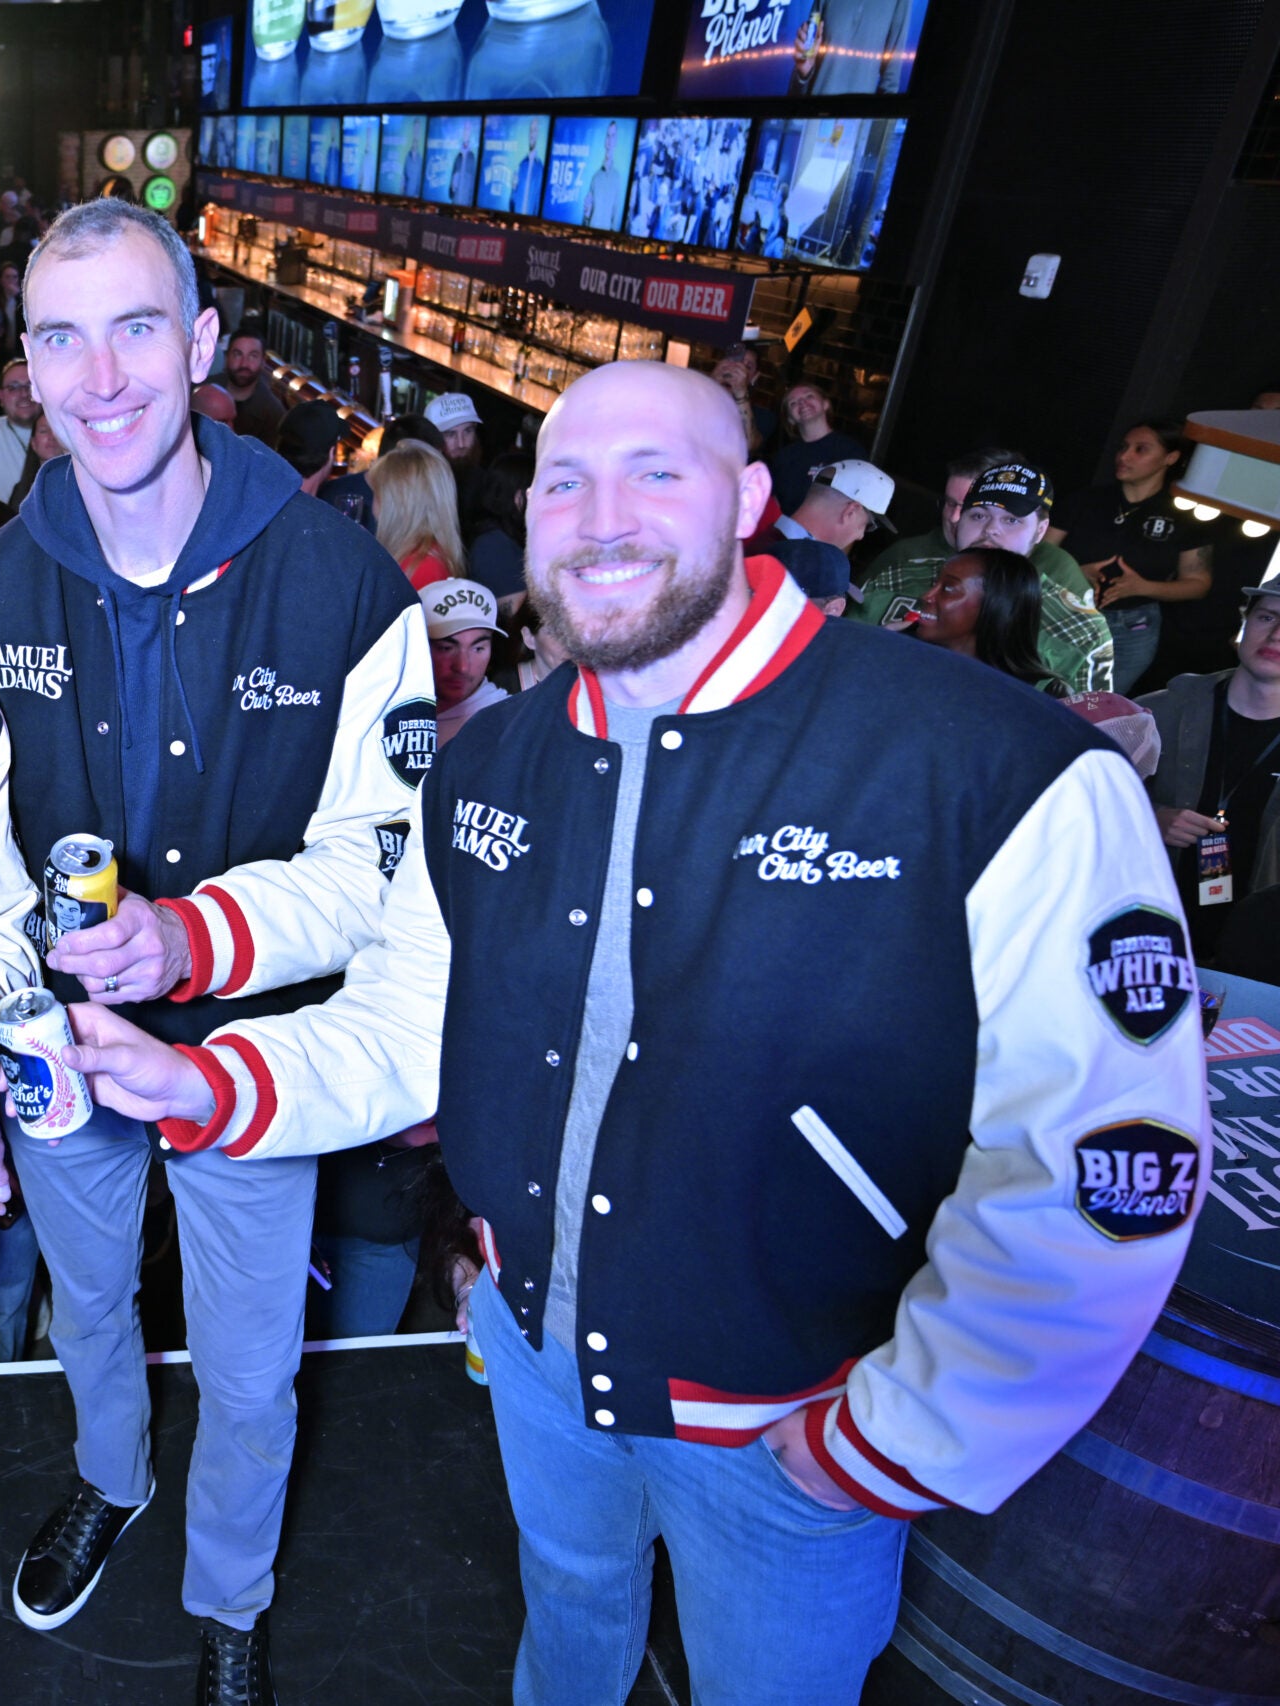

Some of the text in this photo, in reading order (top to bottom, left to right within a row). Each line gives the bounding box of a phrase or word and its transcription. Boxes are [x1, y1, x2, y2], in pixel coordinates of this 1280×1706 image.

[704, 6, 785, 62] Pilsner
[551, 161, 586, 185] BIG Z
[527, 246, 561, 271] SAMUEL
[526, 266, 556, 288] ADAMS
[580, 266, 728, 318] OUR CITY. OUR BEER.
[979, 482, 1028, 495] CHAMPIONS
[1153, 519, 1166, 534] B
[433, 589, 492, 617] BOSTON
[232, 674, 247, 692] ur
[240, 689, 273, 711] Our
[399, 719, 437, 733] (DERRIC
[381, 730, 438, 758] WHIT
[405, 753, 433, 769] ALE
[453, 798, 531, 853] MUEL
[377, 829, 404, 859] BI
[452, 825, 513, 872] AMS
[733, 833, 768, 860] ur
[758, 853, 823, 884] Our
[1086, 953, 1194, 997] WHITE
[1126, 986, 1166, 1013] ALE
[1204, 1022, 1280, 1057] OU
[8, 1082, 53, 1105] chet's
[1220, 1066, 1280, 1098] UR
[27, 1104, 46, 1116] ALE
[1077, 1148, 1196, 1192] BIG Z
[1089, 1186, 1188, 1216] Pilsner
